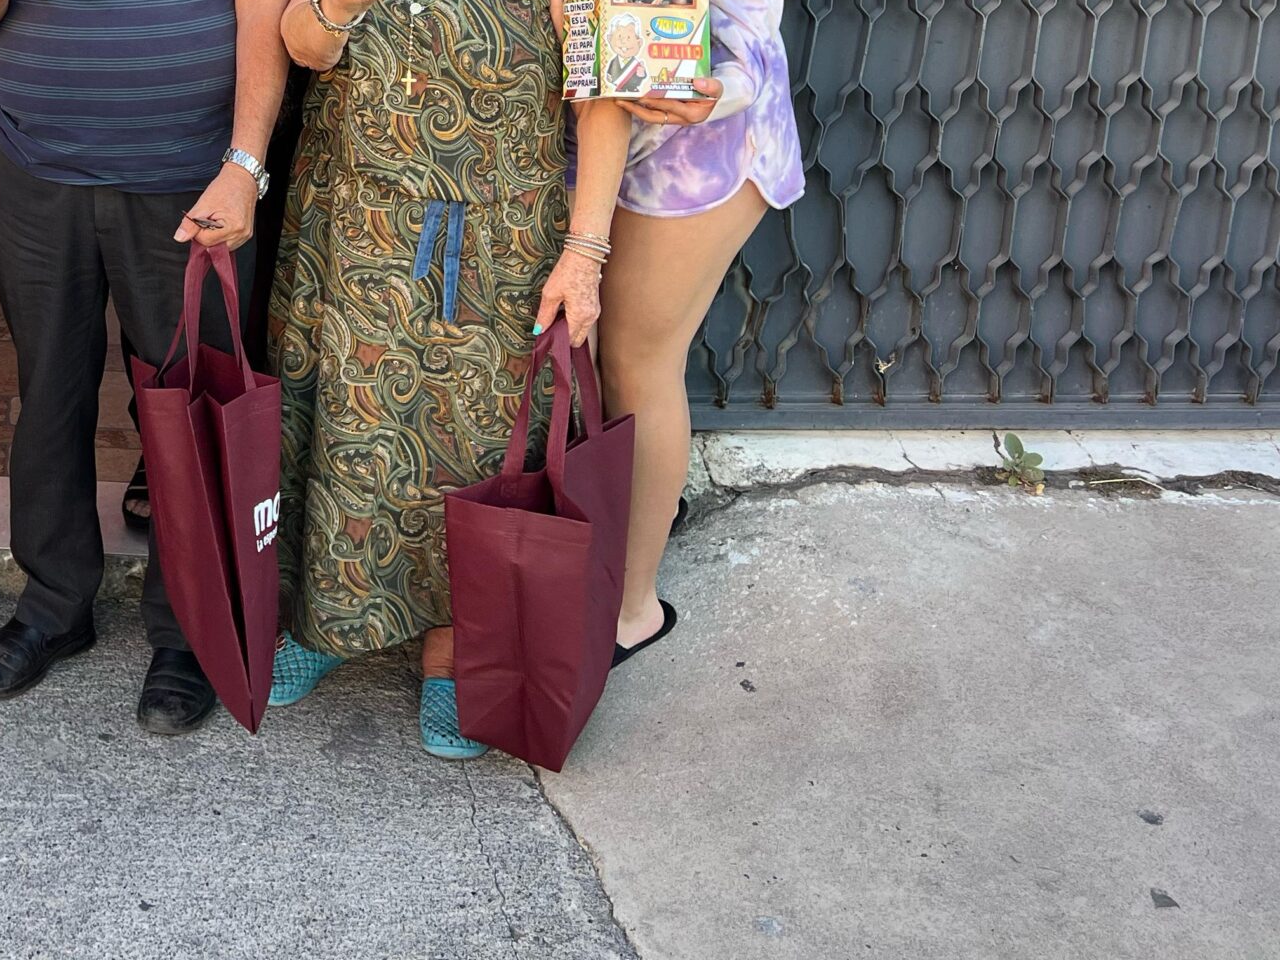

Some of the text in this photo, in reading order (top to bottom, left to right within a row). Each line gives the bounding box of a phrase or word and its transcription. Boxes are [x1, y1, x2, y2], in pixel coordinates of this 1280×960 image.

[570, 2, 594, 12] DINERO
[571, 16, 587, 25] ES LA
[566, 53, 596, 63] DEL DIABLO
[580, 66, 591, 76] QUE
